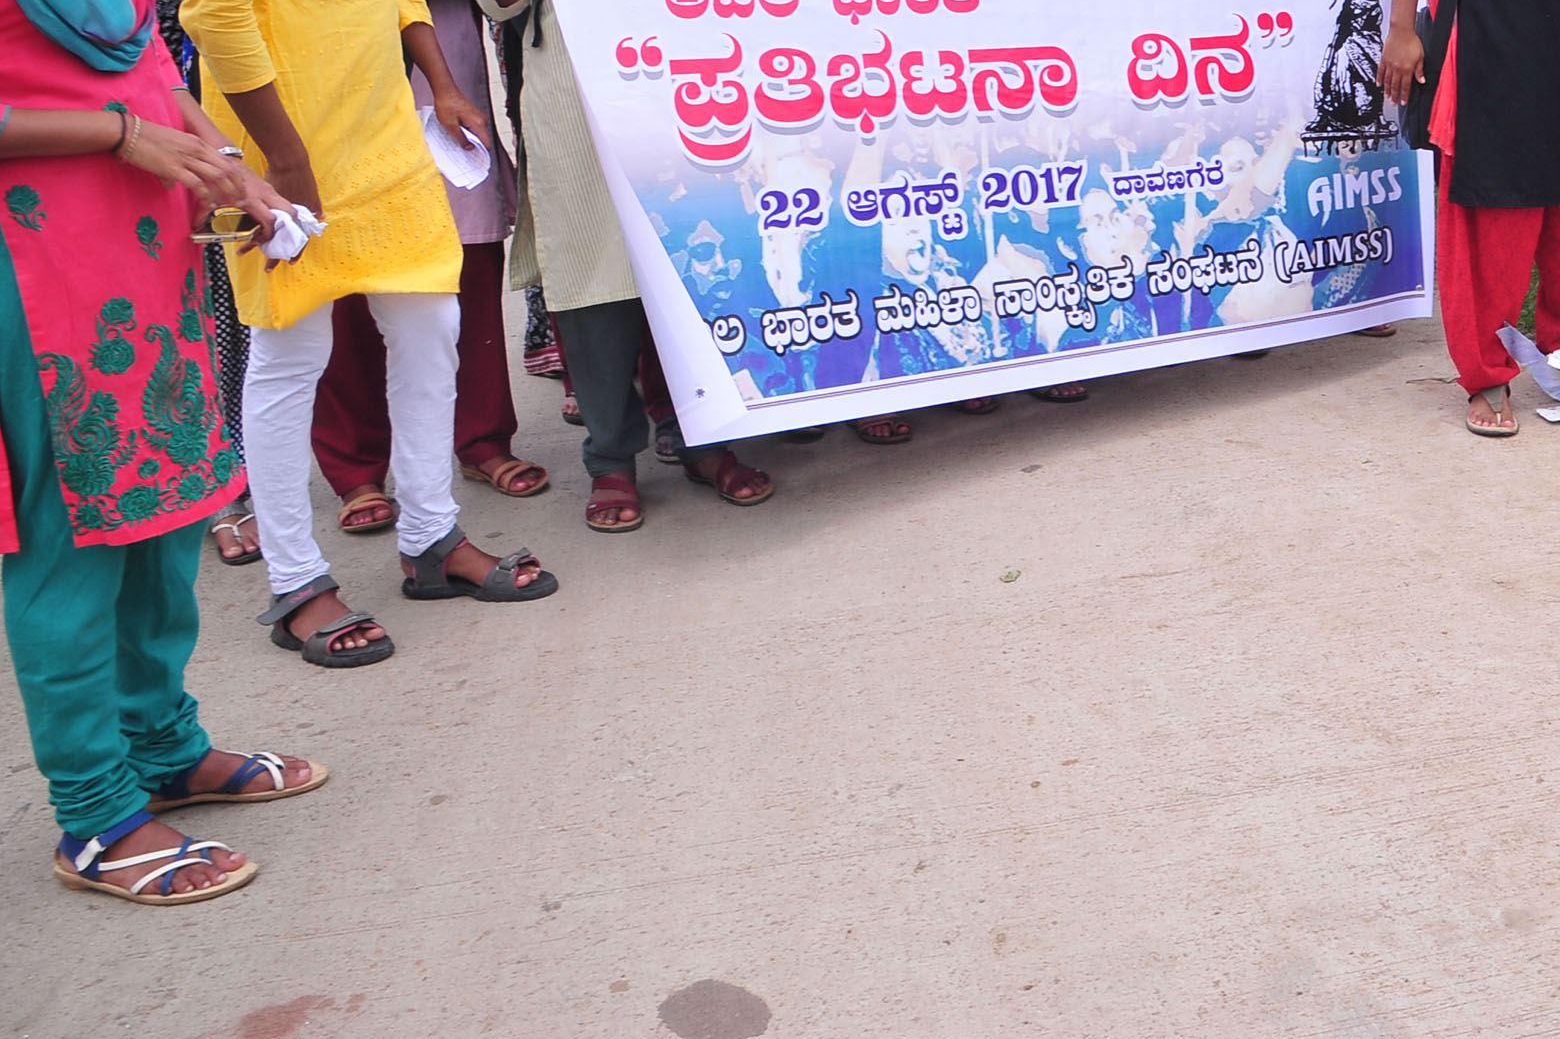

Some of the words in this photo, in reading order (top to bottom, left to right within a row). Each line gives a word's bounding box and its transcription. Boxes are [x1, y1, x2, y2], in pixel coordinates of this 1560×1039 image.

[615, 28, 1078, 162] “ಪ್ರತಿಭಟನಾ
[1127, 11, 1294, 101] ದಿನ”
[760, 187, 823, 230] 22
[847, 171, 965, 235] ಆಗಸ್ಟ್
[982, 164, 1083, 210] 2017
[1112, 160, 1224, 197] ದಾವಣಗೆರೆ
[1308, 166, 1401, 226] AIMSS
[761, 288, 862, 357] ಭಾರತ
[873, 283, 983, 336] ಮಹಿಳಾ
[993, 255, 1136, 331] ಸಾಂಸ್ಕೃತಿಕ
[1147, 237, 1264, 298] ಸಂಘಟನೆ
[1274, 227, 1393, 283] (AIMSS)
